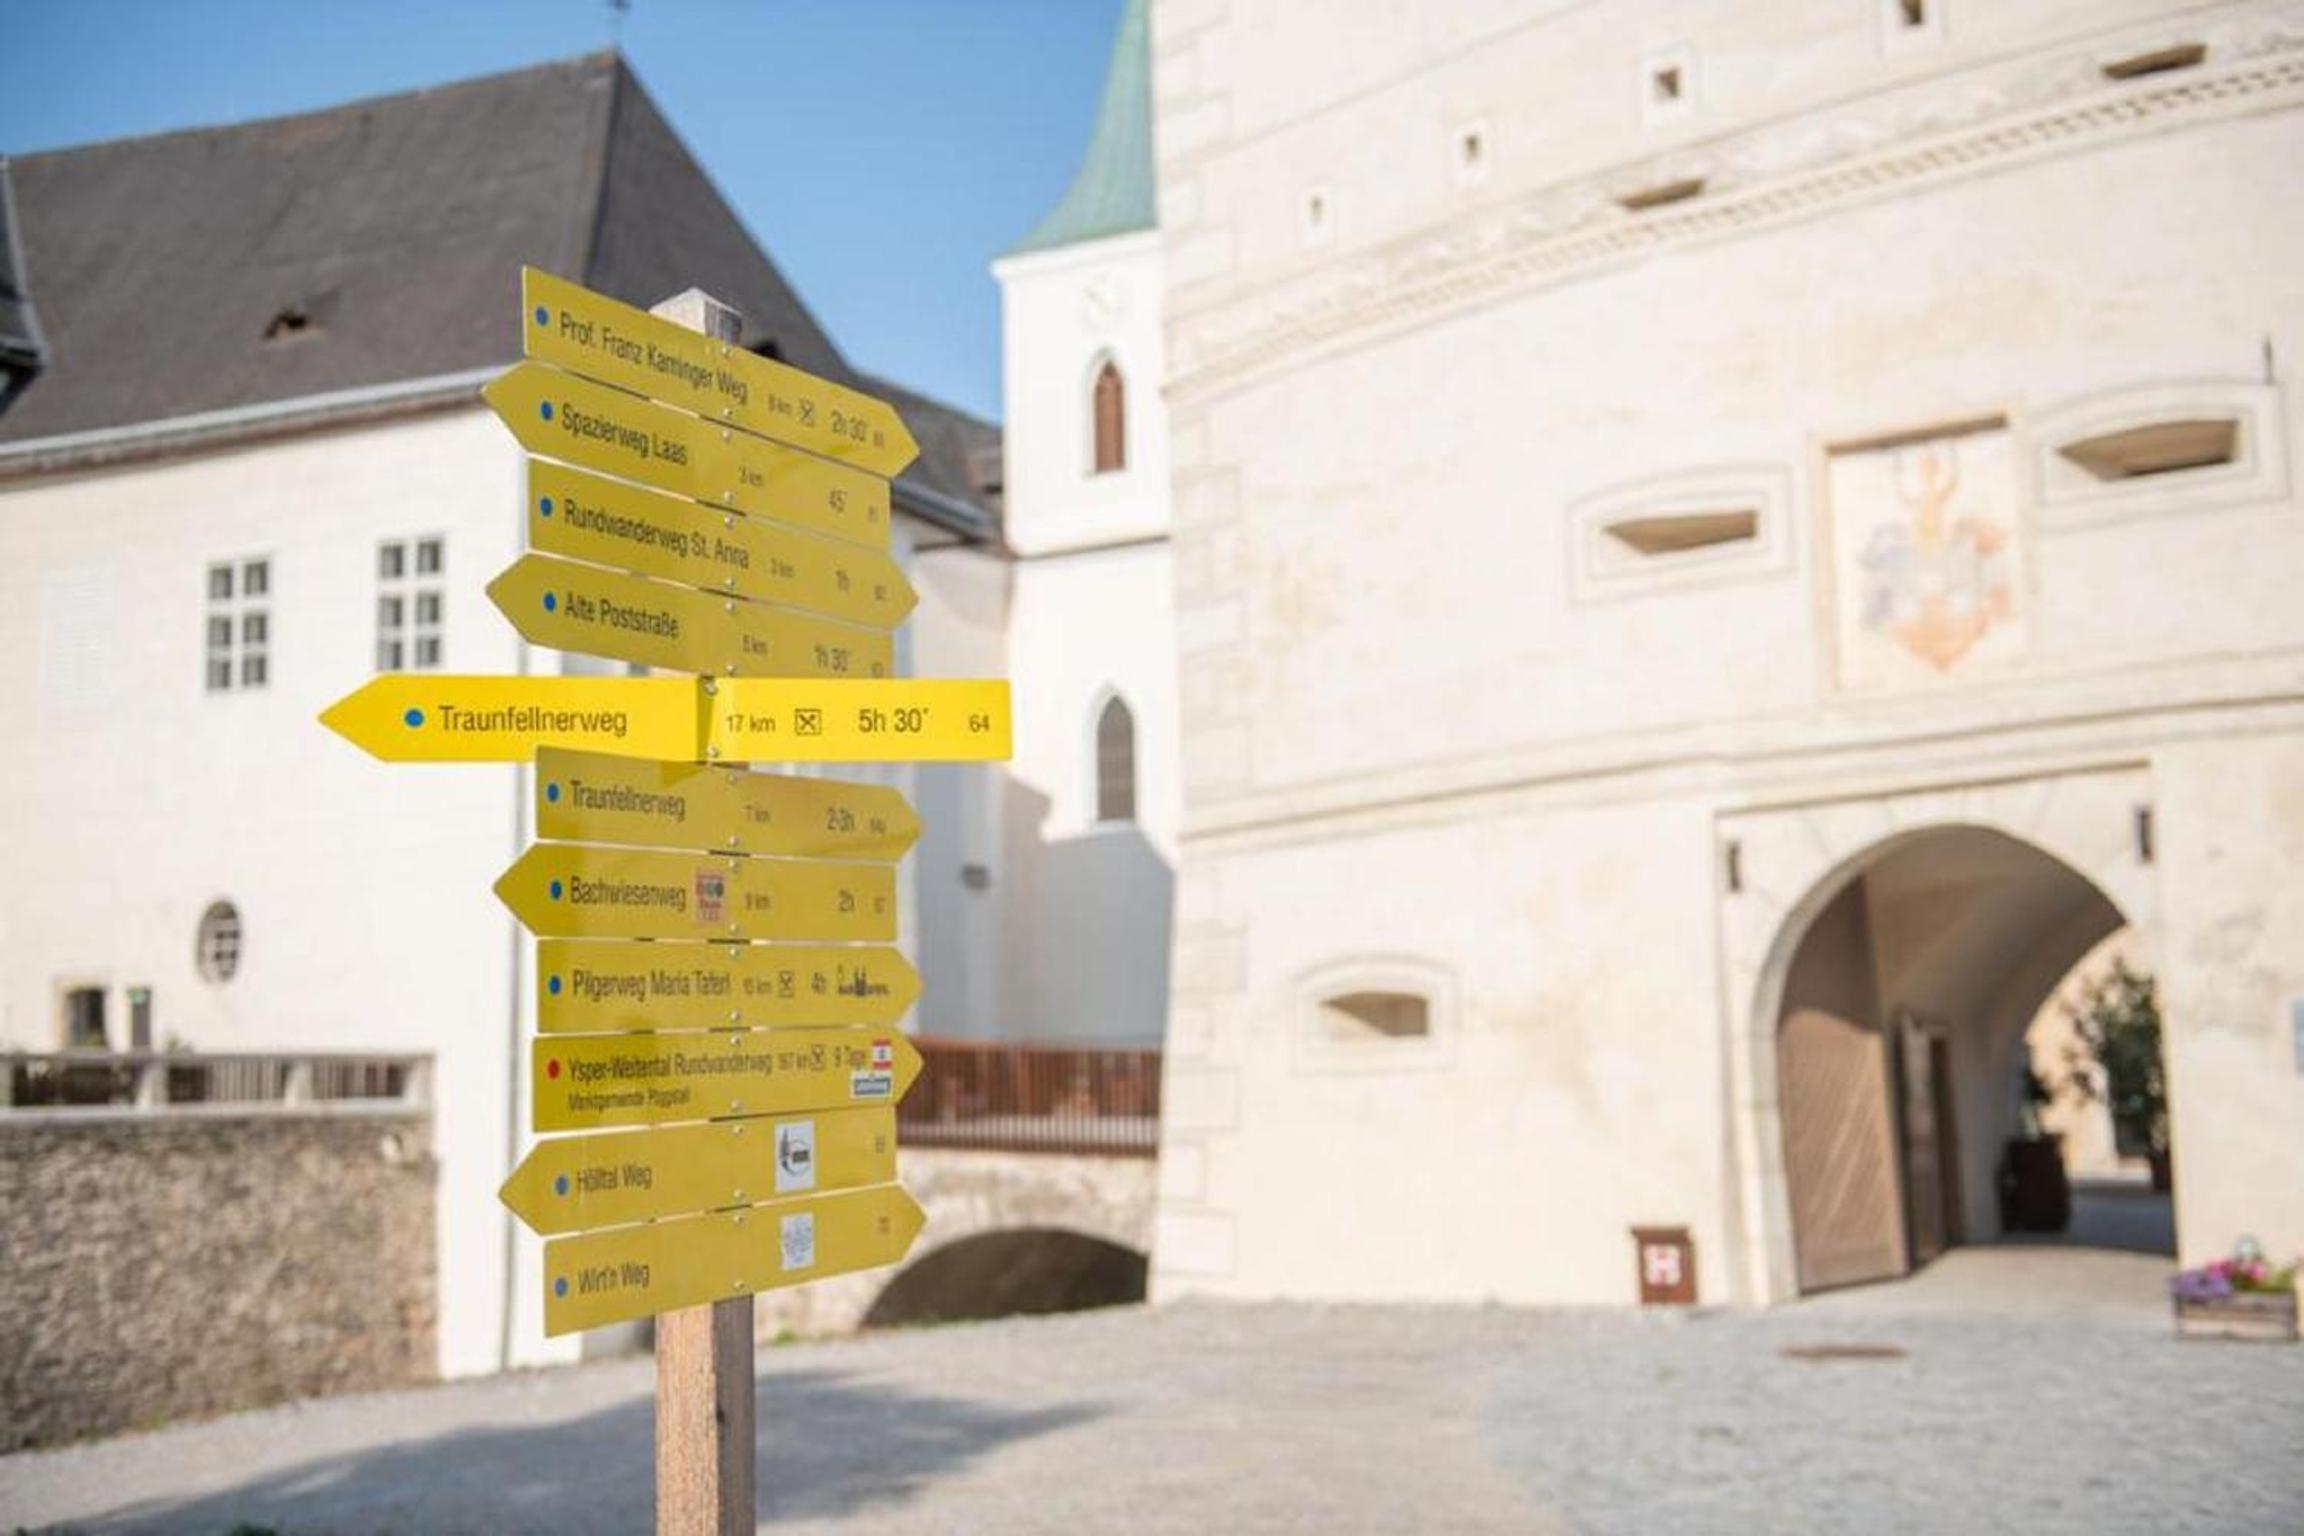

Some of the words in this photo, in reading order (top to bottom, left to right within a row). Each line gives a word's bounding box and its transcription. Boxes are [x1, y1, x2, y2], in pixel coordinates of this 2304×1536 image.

[560, 311, 597, 347] Prof.
[602, 327, 642, 364] Franz
[716, 367, 748, 405] Weg
[562, 402, 649, 459] Spazierweg
[652, 431, 688, 467] Laas
[564, 497, 688, 559] Rundwanderweg
[691, 530, 709, 559] St.
[715, 537, 749, 570] Anna
[564, 591, 595, 623] Alte
[599, 597, 679, 640] Poststraße
[438, 705, 627, 737] Traunfellnerweg
[726, 714, 743, 732] 17
[750, 714, 775, 733] km
[858, 708, 885, 733] 5h
[968, 714, 990, 733] 64
[570, 779, 687, 822] Traunfellnerweg
[570, 874, 687, 913] Bachwiesenweg
[573, 969, 647, 1003] Pilgerweg
[651, 968, 689, 997] Maria
[692, 969, 731, 997] Taferl
[674, 1052, 773, 1077] Rundwanderweg
[622, 1162, 652, 1191] Weg
[620, 1259, 650, 1290] Weg
